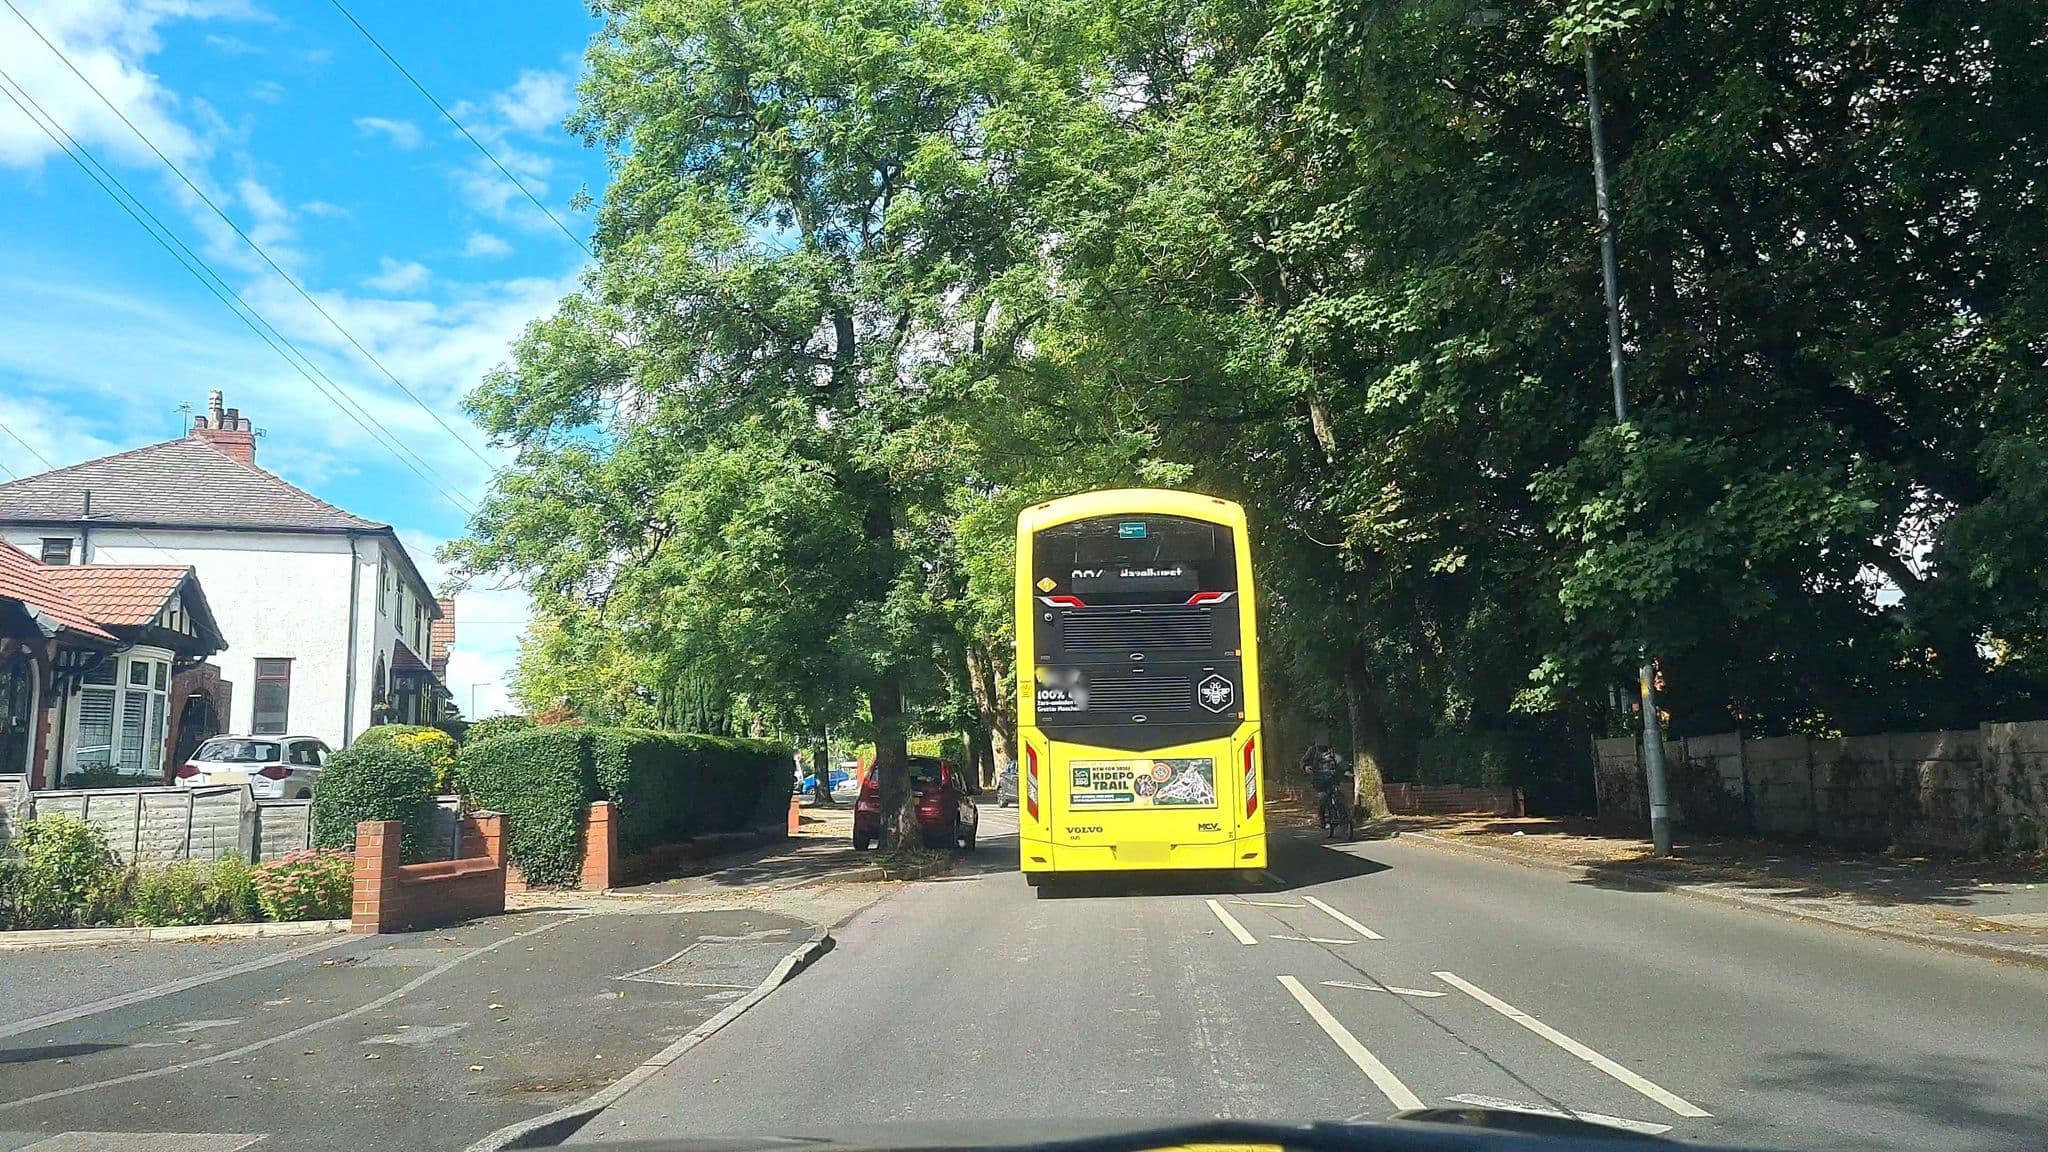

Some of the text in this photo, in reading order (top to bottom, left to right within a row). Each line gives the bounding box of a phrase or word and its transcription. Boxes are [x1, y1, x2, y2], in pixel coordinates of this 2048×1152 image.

[1037, 690, 1065, 700] 100%
[1093, 772, 1134, 780] KIDEPO
[1093, 781, 1129, 791] TRAIL
[1066, 826, 1103, 834] VOLVO
